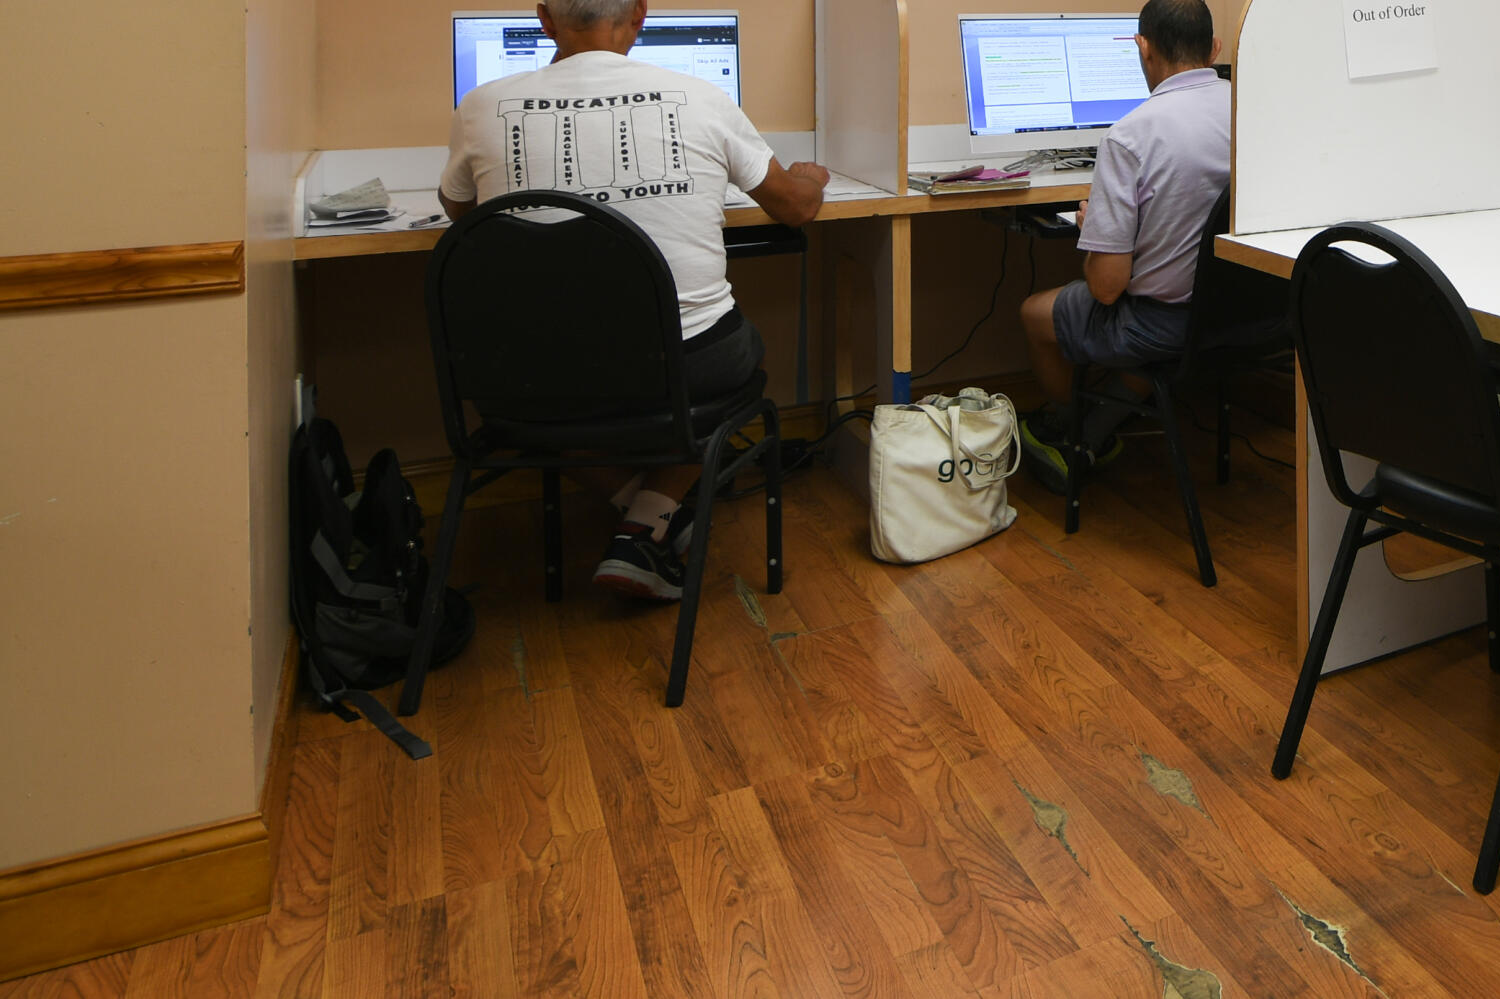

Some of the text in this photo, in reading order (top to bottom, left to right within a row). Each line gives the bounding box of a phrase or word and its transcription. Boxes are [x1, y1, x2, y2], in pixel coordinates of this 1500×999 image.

[1353, 4, 1426, 22] Out of Order
[523, 92, 662, 110] EDUCATION
[512, 125, 523, 187] ADVOCACY
[563, 116, 573, 186] ENGAGEMENT
[620, 120, 629, 171] SUPPORT
[668, 113, 680, 169] RESEARCH
[620, 182, 688, 199] YOUTH
